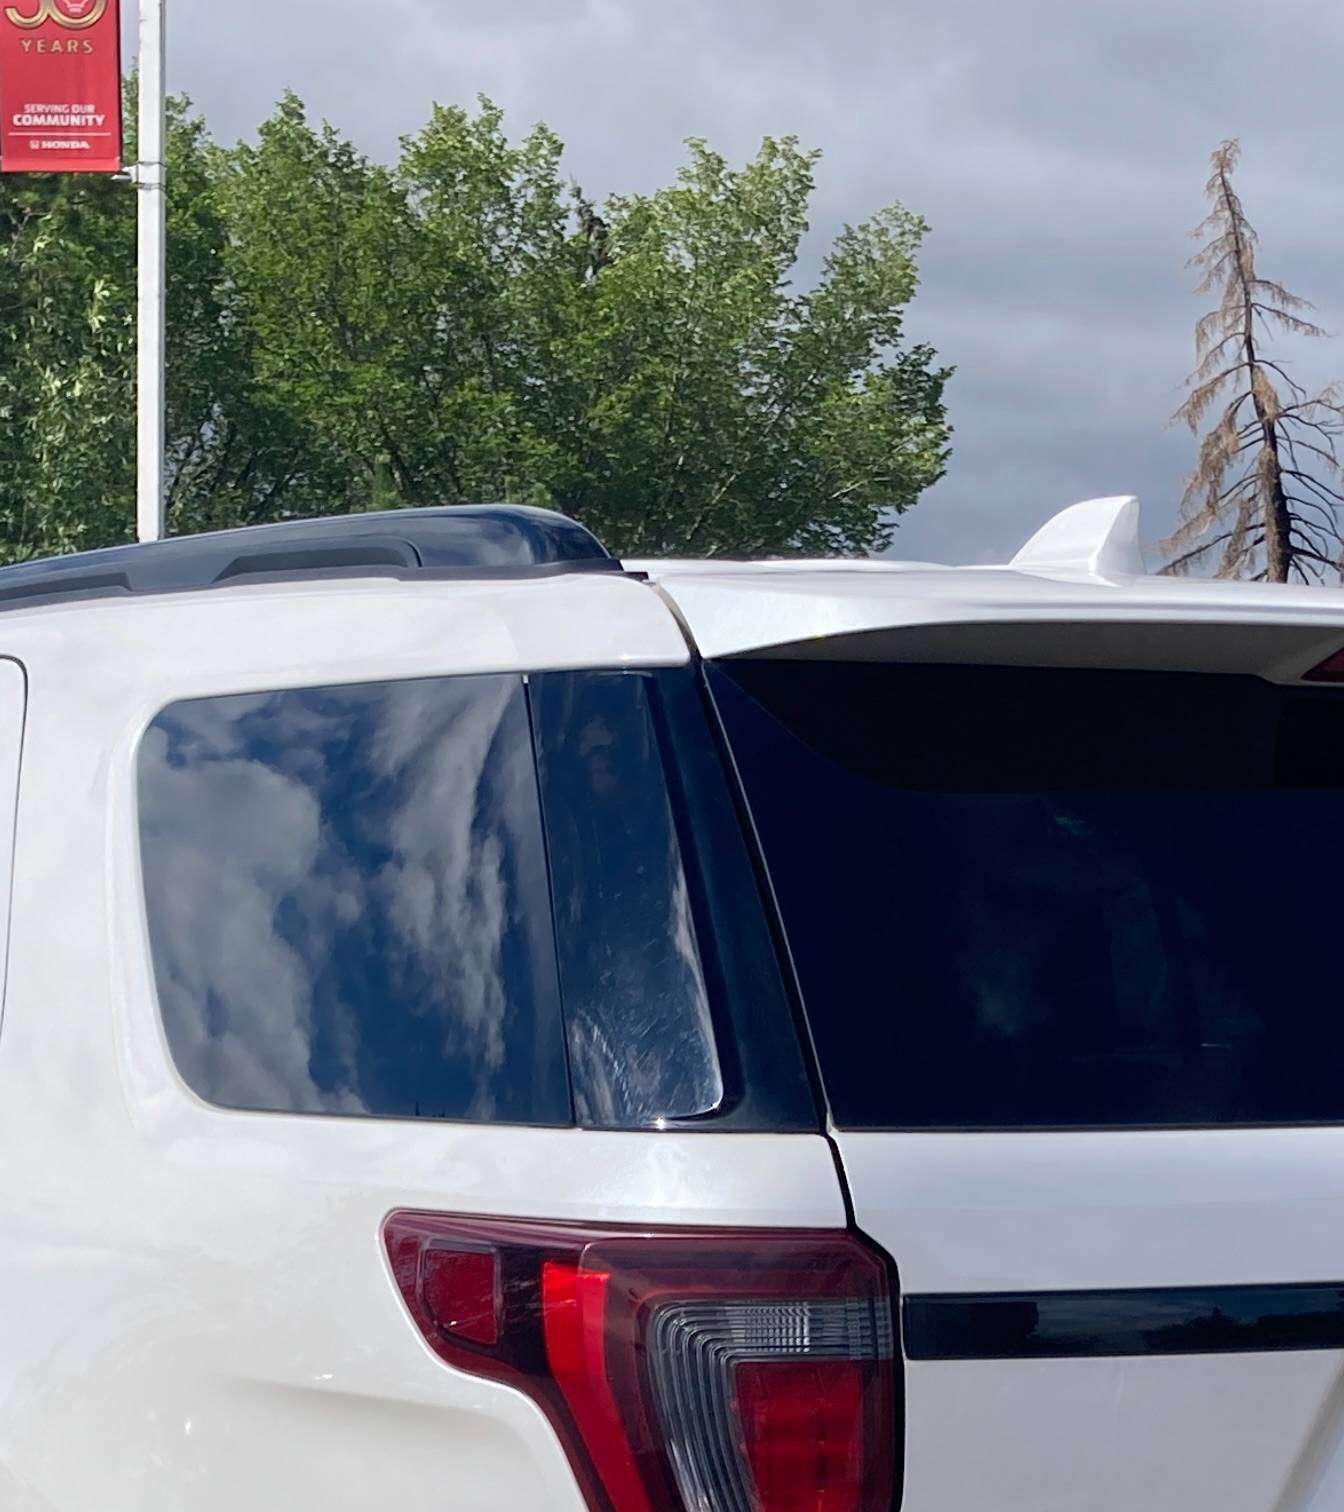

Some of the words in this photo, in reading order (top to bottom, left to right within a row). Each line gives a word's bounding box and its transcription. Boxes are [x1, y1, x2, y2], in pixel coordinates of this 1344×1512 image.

[21, 39, 94, 54] YEARS
[24, 103, 70, 114] SERVING
[71, 103, 96, 114] OUR
[13, 113, 106, 126] COMMUNITY
[41, 140, 90, 149] HONDA
